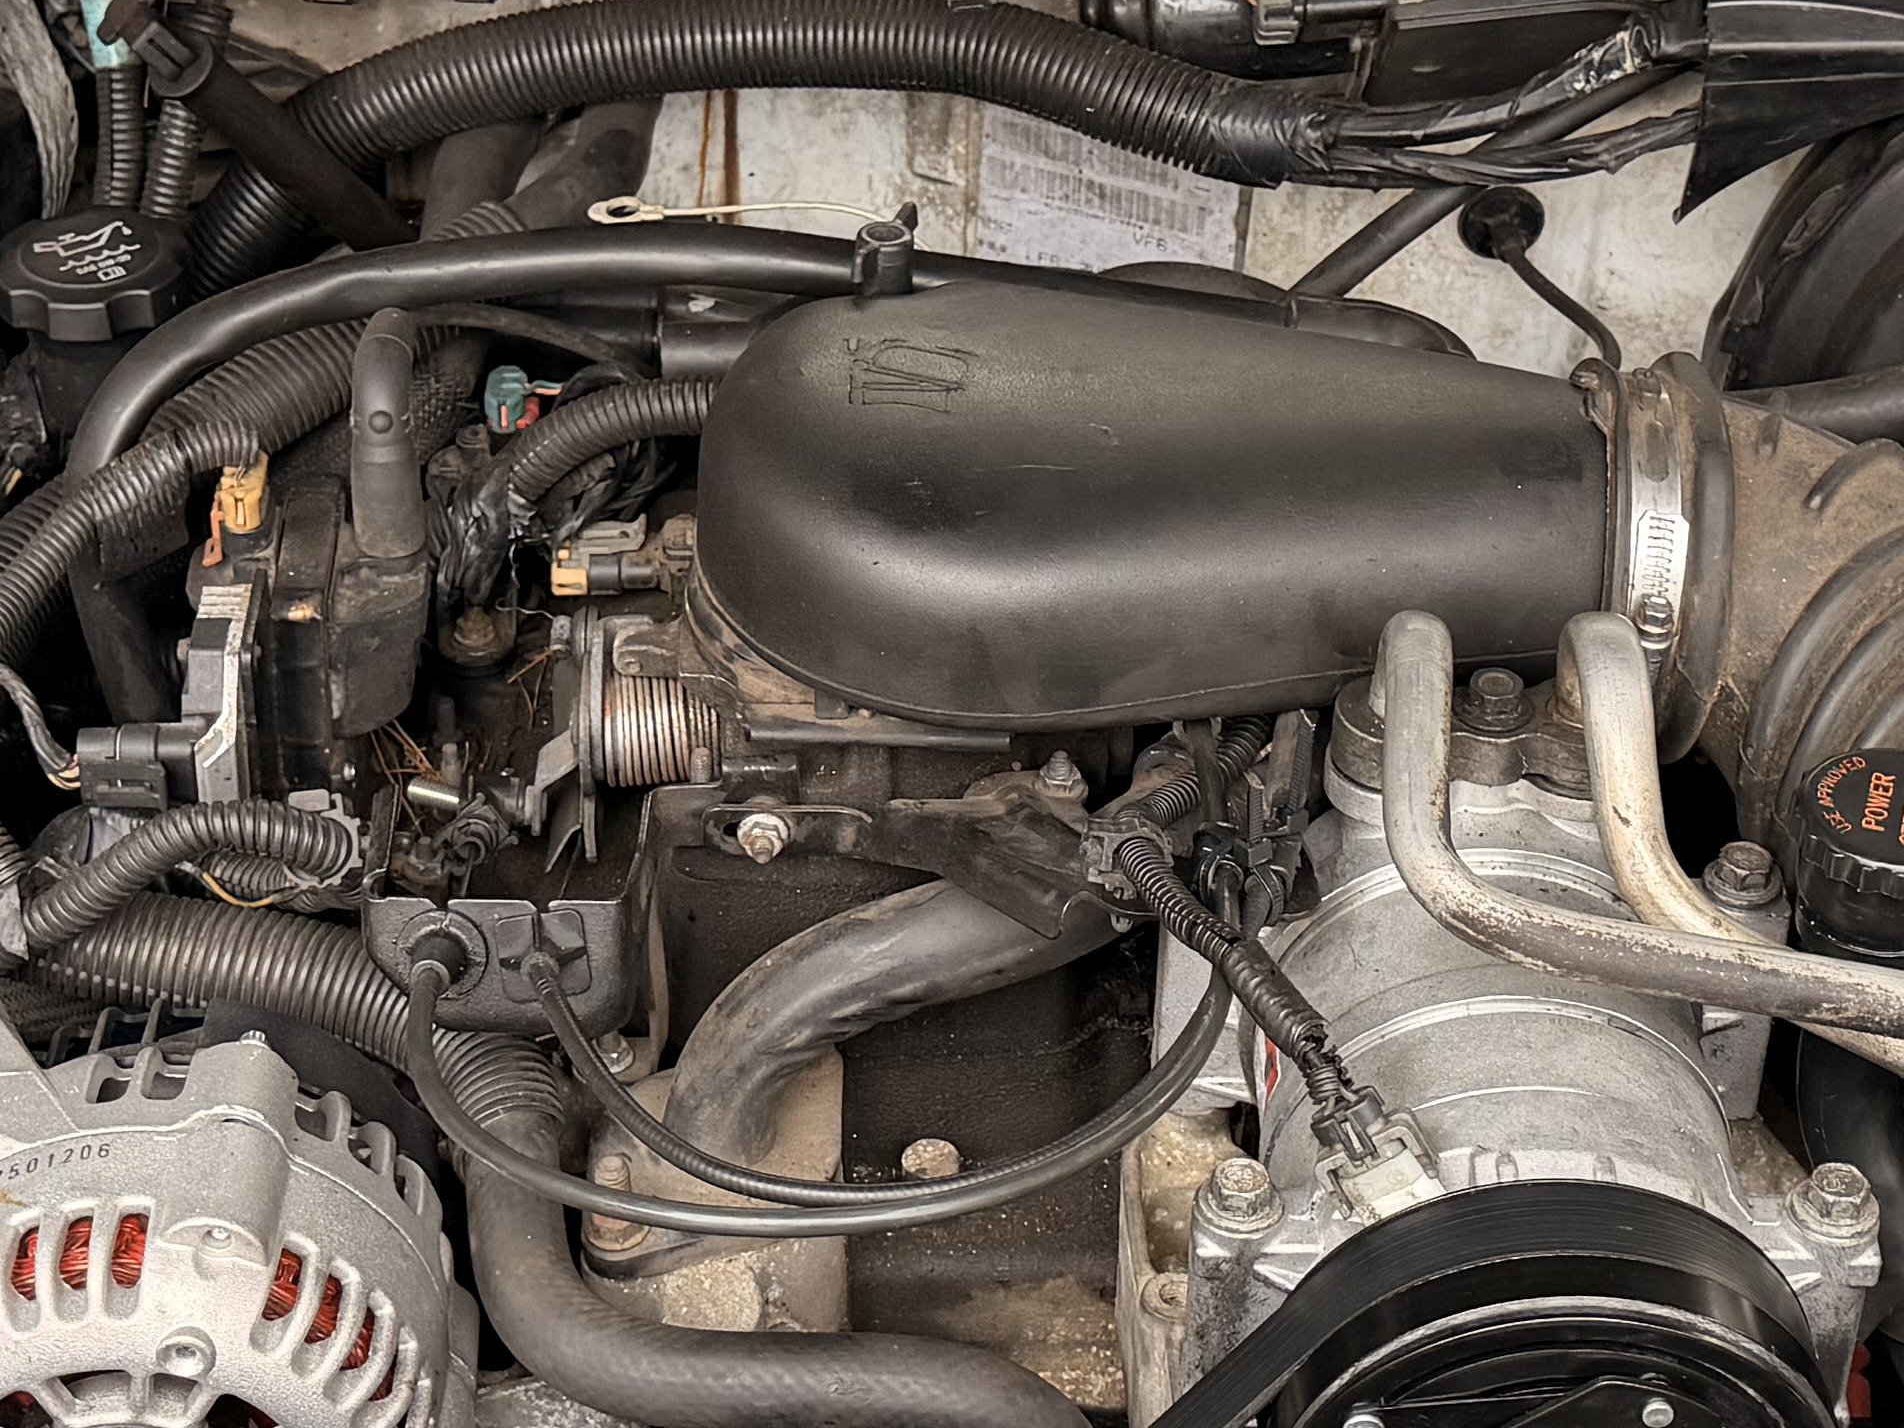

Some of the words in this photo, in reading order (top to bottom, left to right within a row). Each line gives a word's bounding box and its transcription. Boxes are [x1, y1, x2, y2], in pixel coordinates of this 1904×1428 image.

[1816, 756, 1867, 807] APPROVED
[1862, 772, 1896, 832] POWER
[1823, 810, 1852, 834] USE
